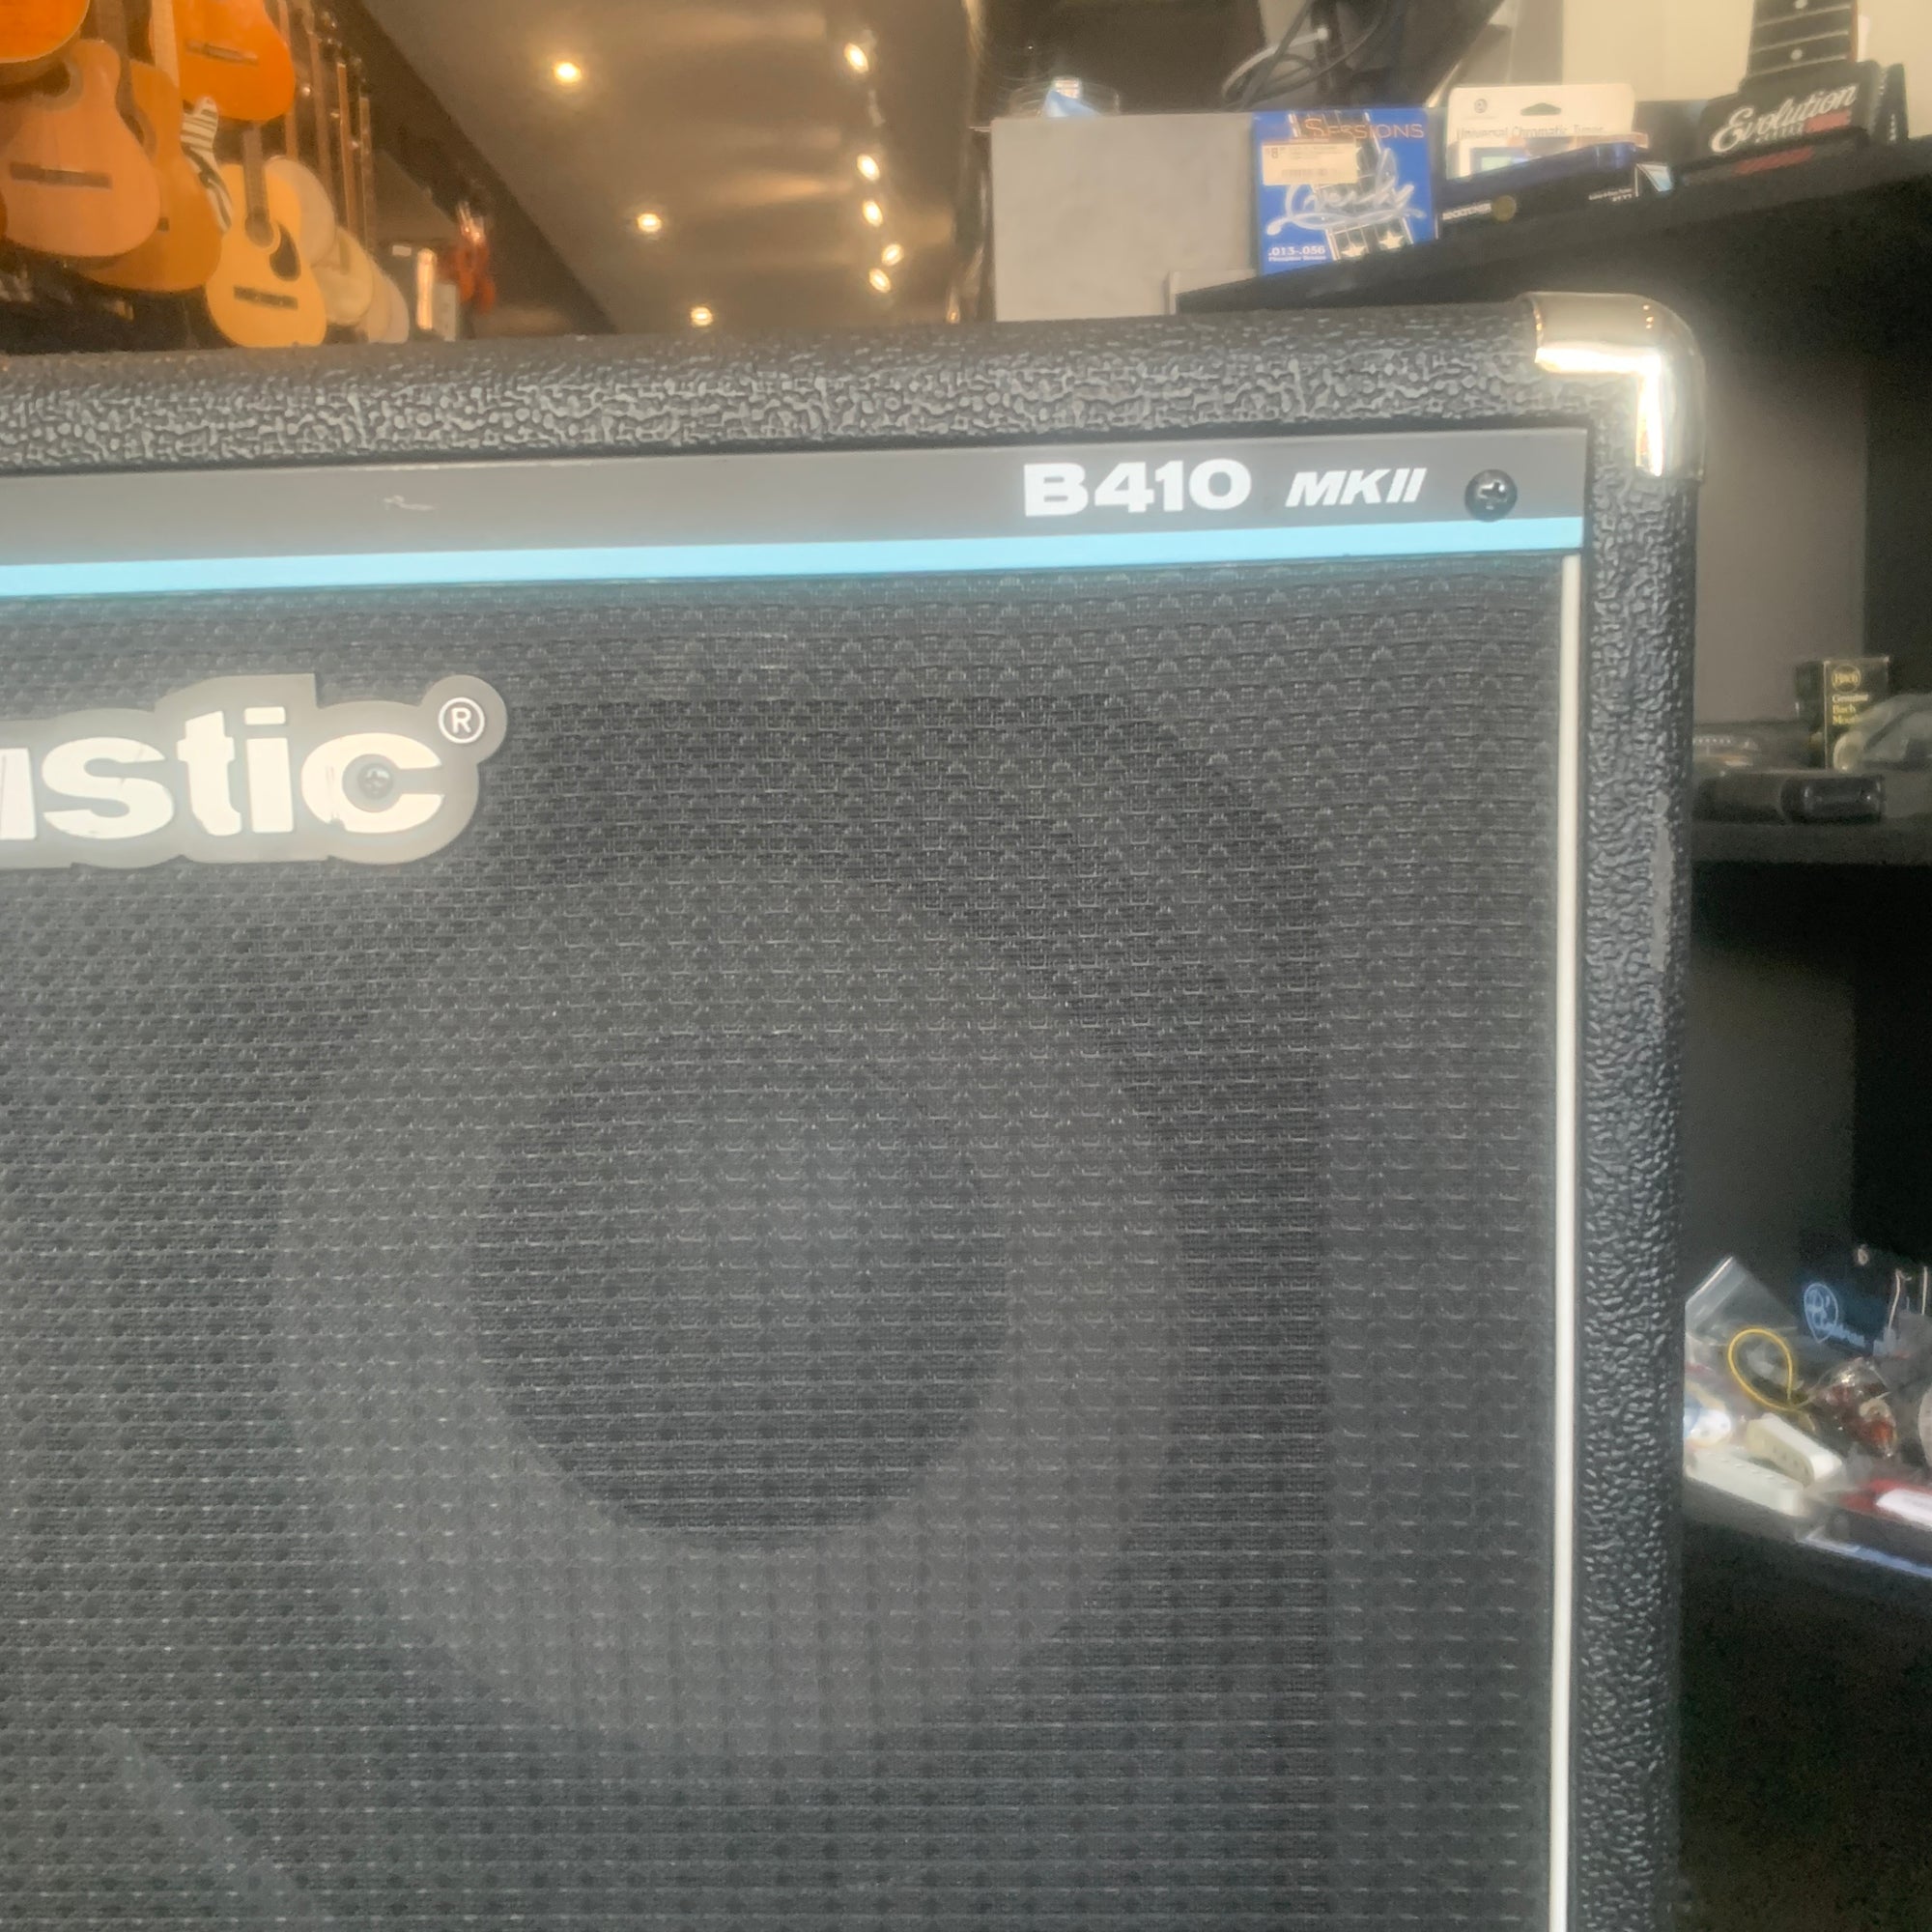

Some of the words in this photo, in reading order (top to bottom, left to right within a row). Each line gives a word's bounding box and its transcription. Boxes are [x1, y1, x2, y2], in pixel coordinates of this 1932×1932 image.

[1304, 118, 1425, 139] SESSIONS
[1708, 83, 1859, 154] Evolution
[1024, 458, 1252, 517] B410
[1286, 468, 1428, 508] MKII
